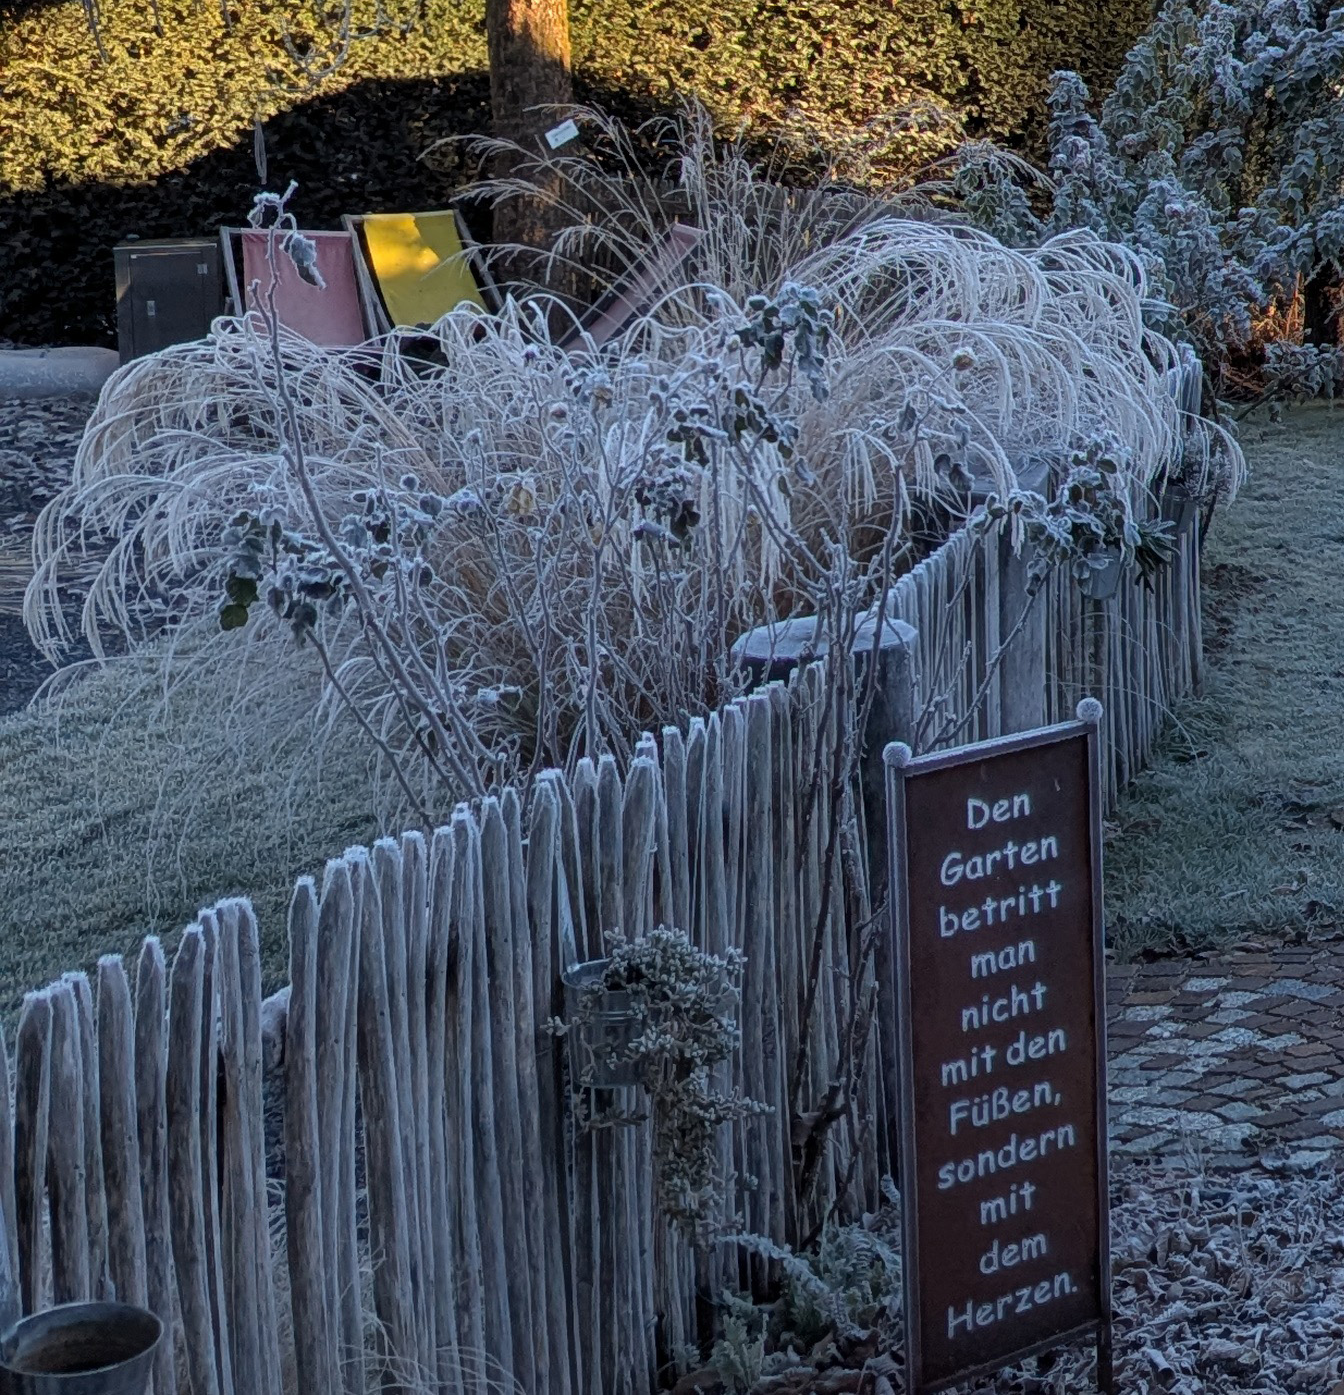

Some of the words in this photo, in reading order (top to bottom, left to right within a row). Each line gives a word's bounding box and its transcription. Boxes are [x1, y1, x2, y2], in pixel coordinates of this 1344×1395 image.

[967, 793, 1030, 829] Den
[940, 835, 1058, 886] Garten
[939, 880, 1062, 937] betritt
[971, 940, 1035, 978] man
[962, 982, 1047, 1032] nicht
[941, 1045, 996, 1086] mit
[1006, 1028, 1066, 1065] den
[950, 1081, 1061, 1135] Füßen,
[938, 1124, 1075, 1189] sondern
[981, 1181, 1036, 1225] mit
[979, 1233, 1047, 1274] dem
[948, 1271, 1078, 1339] Herzen.
